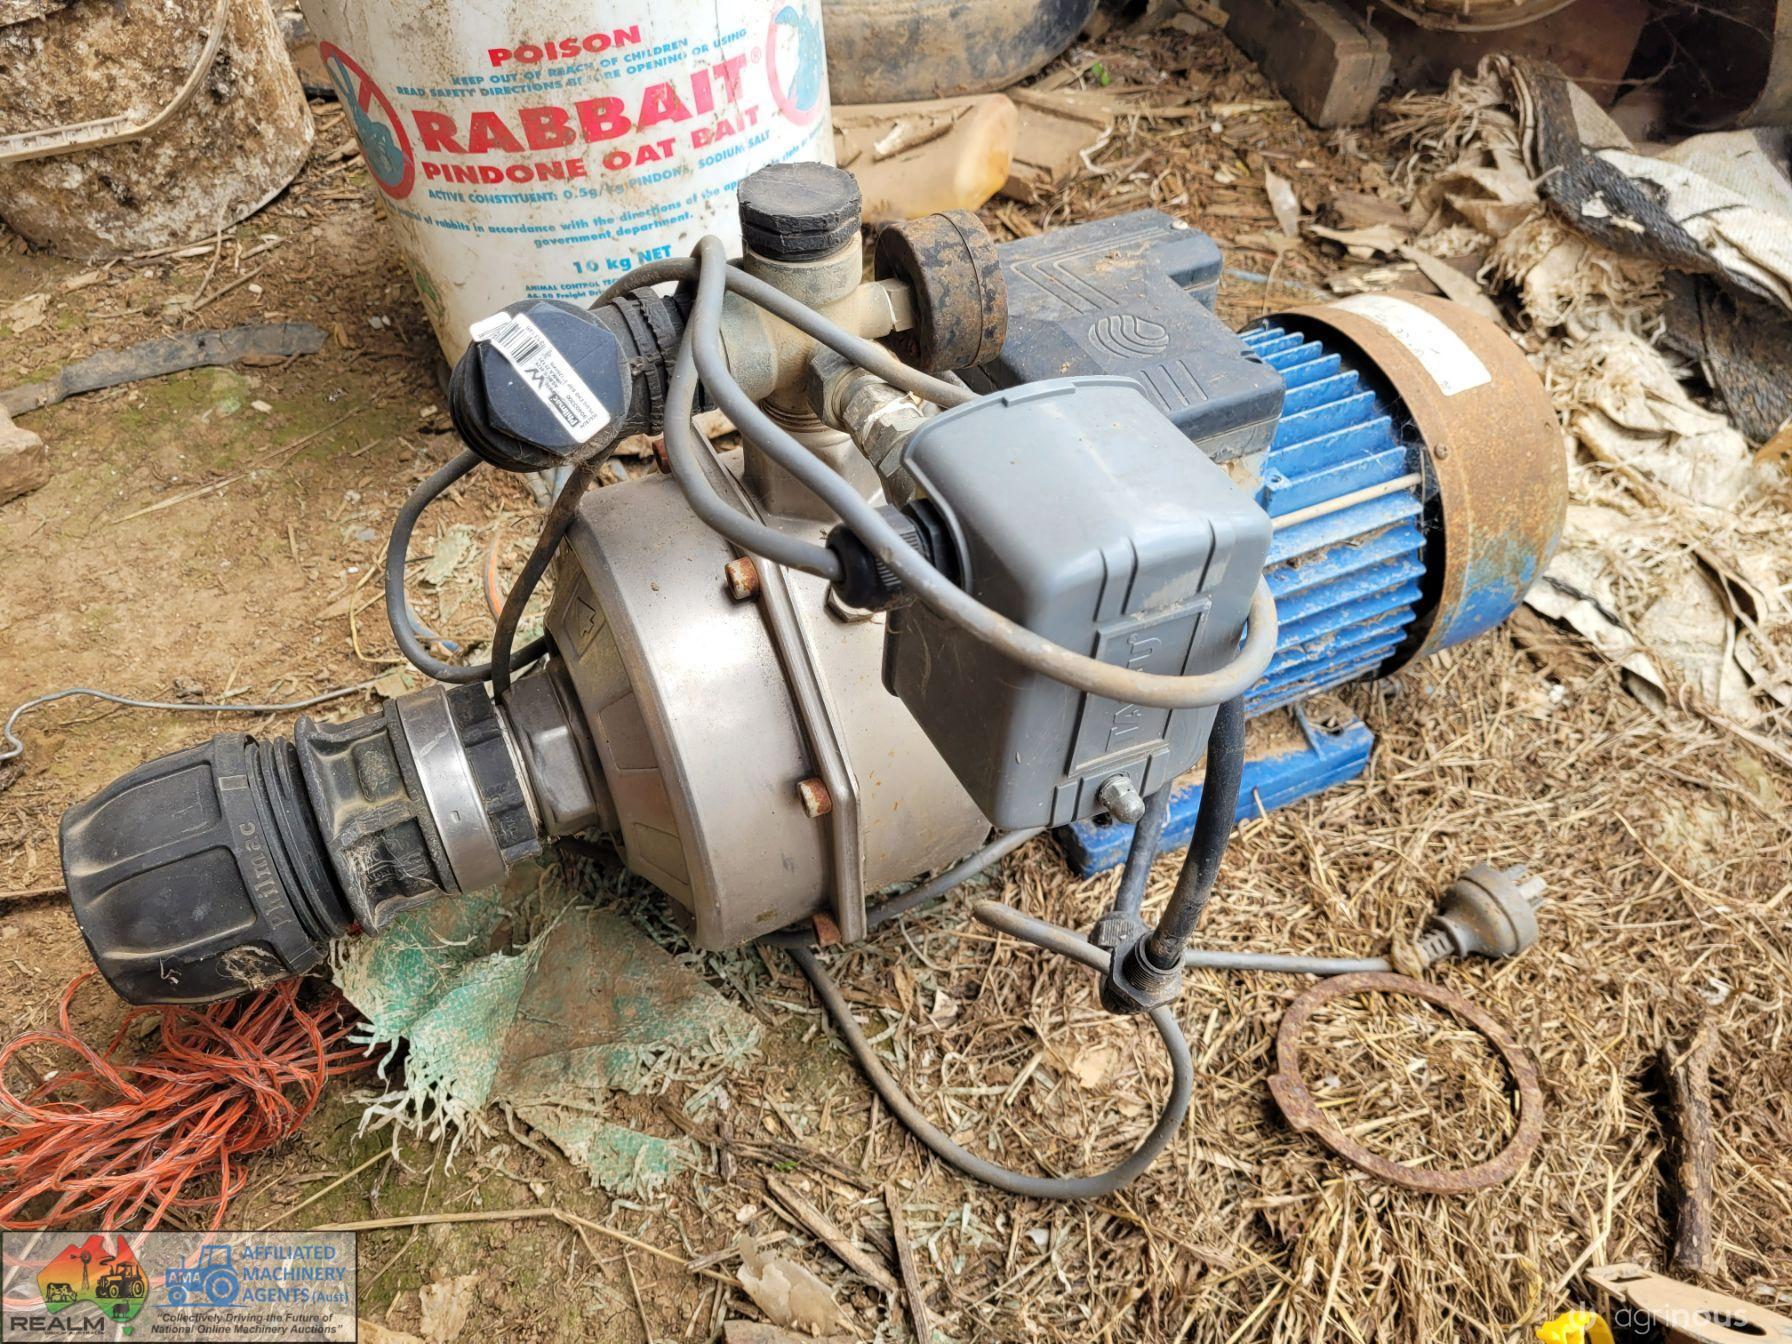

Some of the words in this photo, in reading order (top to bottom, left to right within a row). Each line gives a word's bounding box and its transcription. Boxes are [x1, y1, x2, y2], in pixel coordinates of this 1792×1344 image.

[396, 86, 425, 97] READ
[430, 87, 476, 97] SAFETY
[480, 81, 563, 97] DIRECTIONS
[692, 44, 709, 56] OR
[713, 28, 747, 49] USING
[452, 75, 485, 86] KEEP
[489, 73, 518, 83] OUT
[523, 71, 542, 81] OF
[600, 57, 618, 68] OF
[623, 38, 688, 63] CHILDREN
[488, 25, 641, 67] POISON
[422, 158, 588, 184] PINDONE
[602, 138, 677, 171] OAT
[691, 105, 759, 149] BAIT
[428, 189, 465, 203] ACTIVE
[470, 191, 558, 204] CONSTITUENT:
[748, 129, 770, 149] SALT
[435, 219, 471, 231] rabbits
[473, 223, 485, 232] in
[488, 220, 556, 234] accordance
[560, 215, 590, 231] with
[593, 215, 615, 227] the
[619, 200, 682, 222] directions
[534, 230, 612, 248] government
[573, 260, 599, 274] 10
[606, 257, 632, 271] kg
[638, 245, 672, 265] NET
[525, 283, 558, 292] ANIMAL
[560, 281, 600, 291] CONTROL
[551, 395, 579, 426] Philmac
[239, 821, 290, 930] Philmac
